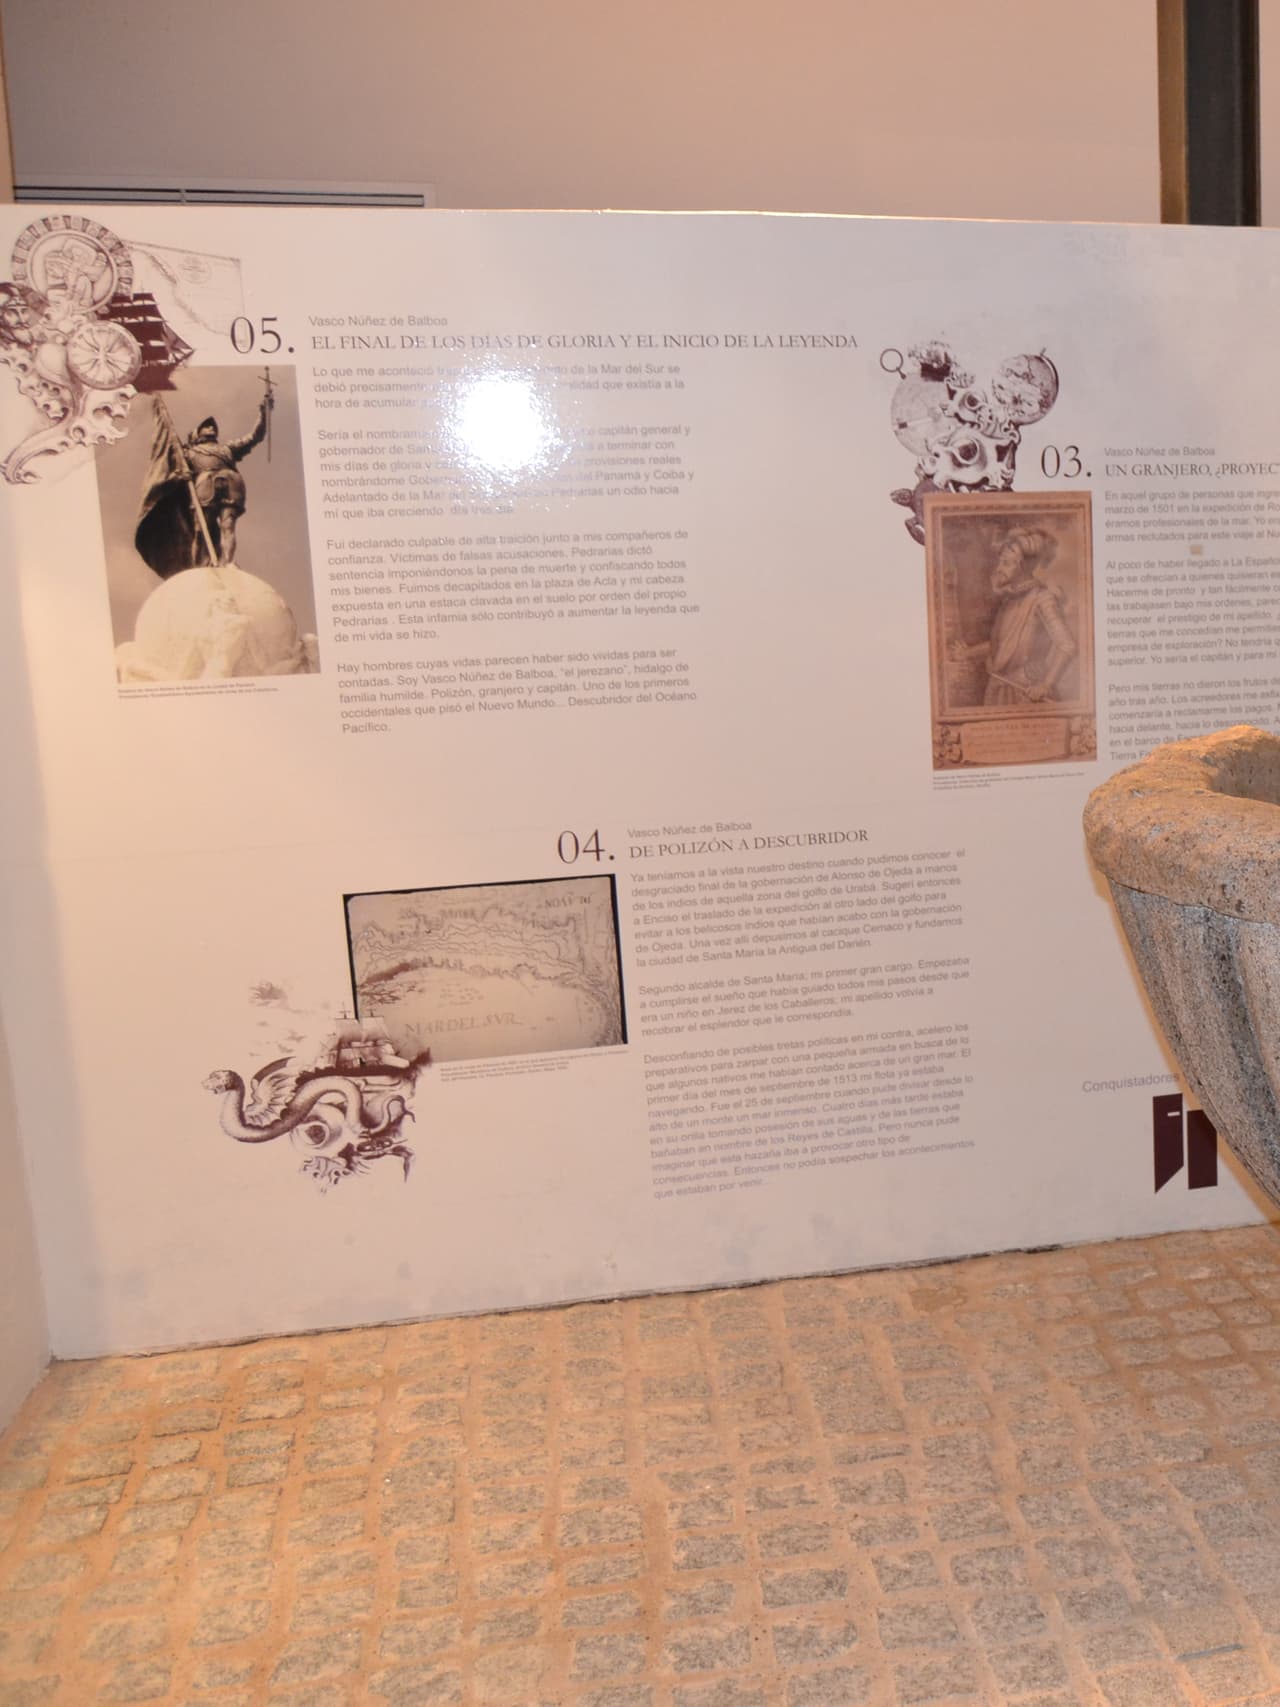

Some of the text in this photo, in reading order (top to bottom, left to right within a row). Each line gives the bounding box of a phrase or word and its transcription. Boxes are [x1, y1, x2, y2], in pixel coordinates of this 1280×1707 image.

[307, 314, 448, 327] Vasco Núñez de Balboa
[229, 316, 295, 354] 05.
[311, 335, 336, 350] EL
[340, 335, 396, 349] FINAL
[400, 335, 426, 349] DE
[431, 335, 466, 349] LOS
[517, 334, 544, 349] DE
[547, 334, 616, 348] GLORIA
[619, 334, 631, 348] Y
[636, 334, 658, 348] EL
[663, 334, 719, 348] INICIO
[723, 334, 748, 348] DE
[753, 335, 774, 348] LA
[779, 334, 858, 348] LEYENDA
[1040, 444, 1092, 479] 03.
[1103, 447, 1134, 457] Vasco
[1167, 447, 1181, 456] de
[1182, 445, 1216, 456] Balboa
[1105, 463, 1127, 476] UN
[1130, 463, 1213, 479] GRANJERO,
[326, 538, 345, 550] Fui
[347, 537, 406, 550] declarado
[407, 535, 455, 549] culpable
[458, 536, 473, 546] de
[498, 534, 540, 545] traición
[542, 533, 570, 545] junto
[572, 533, 580, 542] a
[582, 533, 602, 542] mis
[604, 530, 672, 542] compañeros
[674, 529, 688, 539] de
[336, 649, 677, 675] Hay hombres cuyas vidas parecen haber sido vividas para ser
[338, 676, 394, 689] contadas.
[396, 674, 419, 687] Soy
[420, 674, 457, 684] Vasco
[458, 671, 496, 682] Núñez
[498, 670, 513, 680] de
[633, 663, 673, 675] hidalgo
[674, 662, 689, 672] de
[339, 692, 377, 704] familia
[478, 685, 525, 699] granjero
[526, 686, 534, 696] y
[582, 681, 606, 691] Uno
[607, 679, 622, 690] de
[624, 679, 640, 689] los
[642, 678, 690, 690] primeros
[340, 705, 412, 719] occidentales
[414, 705, 436, 717] que
[438, 702, 463, 715] pisó
[464, 701, 475, 712] el
[477, 700, 515, 712] Nuevo
[567, 694, 633, 707] Descubridor
[635, 692, 652, 703] del
[654, 691, 697, 702] Océano
[626, 821, 752, 839] Vasco Núñez de Balboa
[557, 828, 615, 865] 04.
[628, 829, 868, 858] DE POLIZÓN A DESCUBRIDOR
[629, 872, 645, 883] Ya
